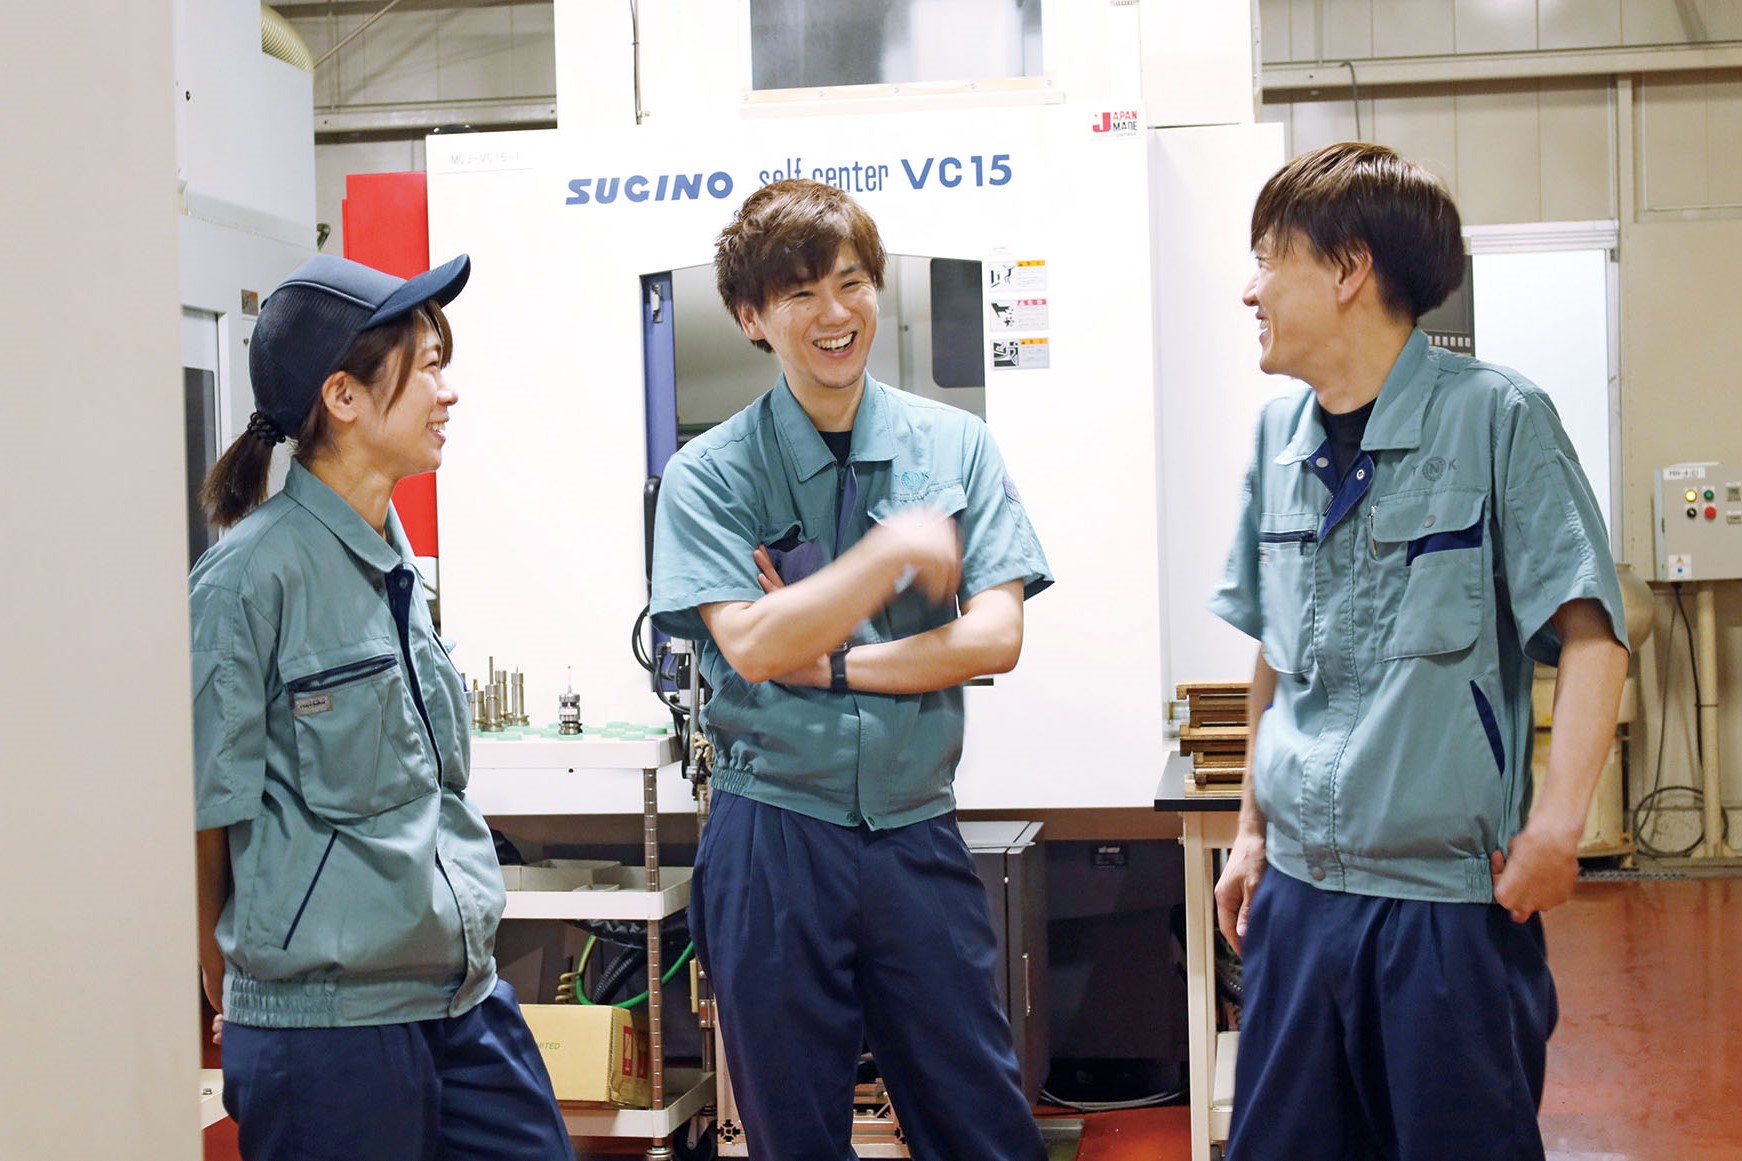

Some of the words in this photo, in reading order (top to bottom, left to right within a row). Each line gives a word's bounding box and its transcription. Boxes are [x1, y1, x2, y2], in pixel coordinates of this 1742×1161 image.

[565, 171, 734, 205] SUGINO
[812, 161, 889, 193] center
[901, 154, 1012, 189] VC15
